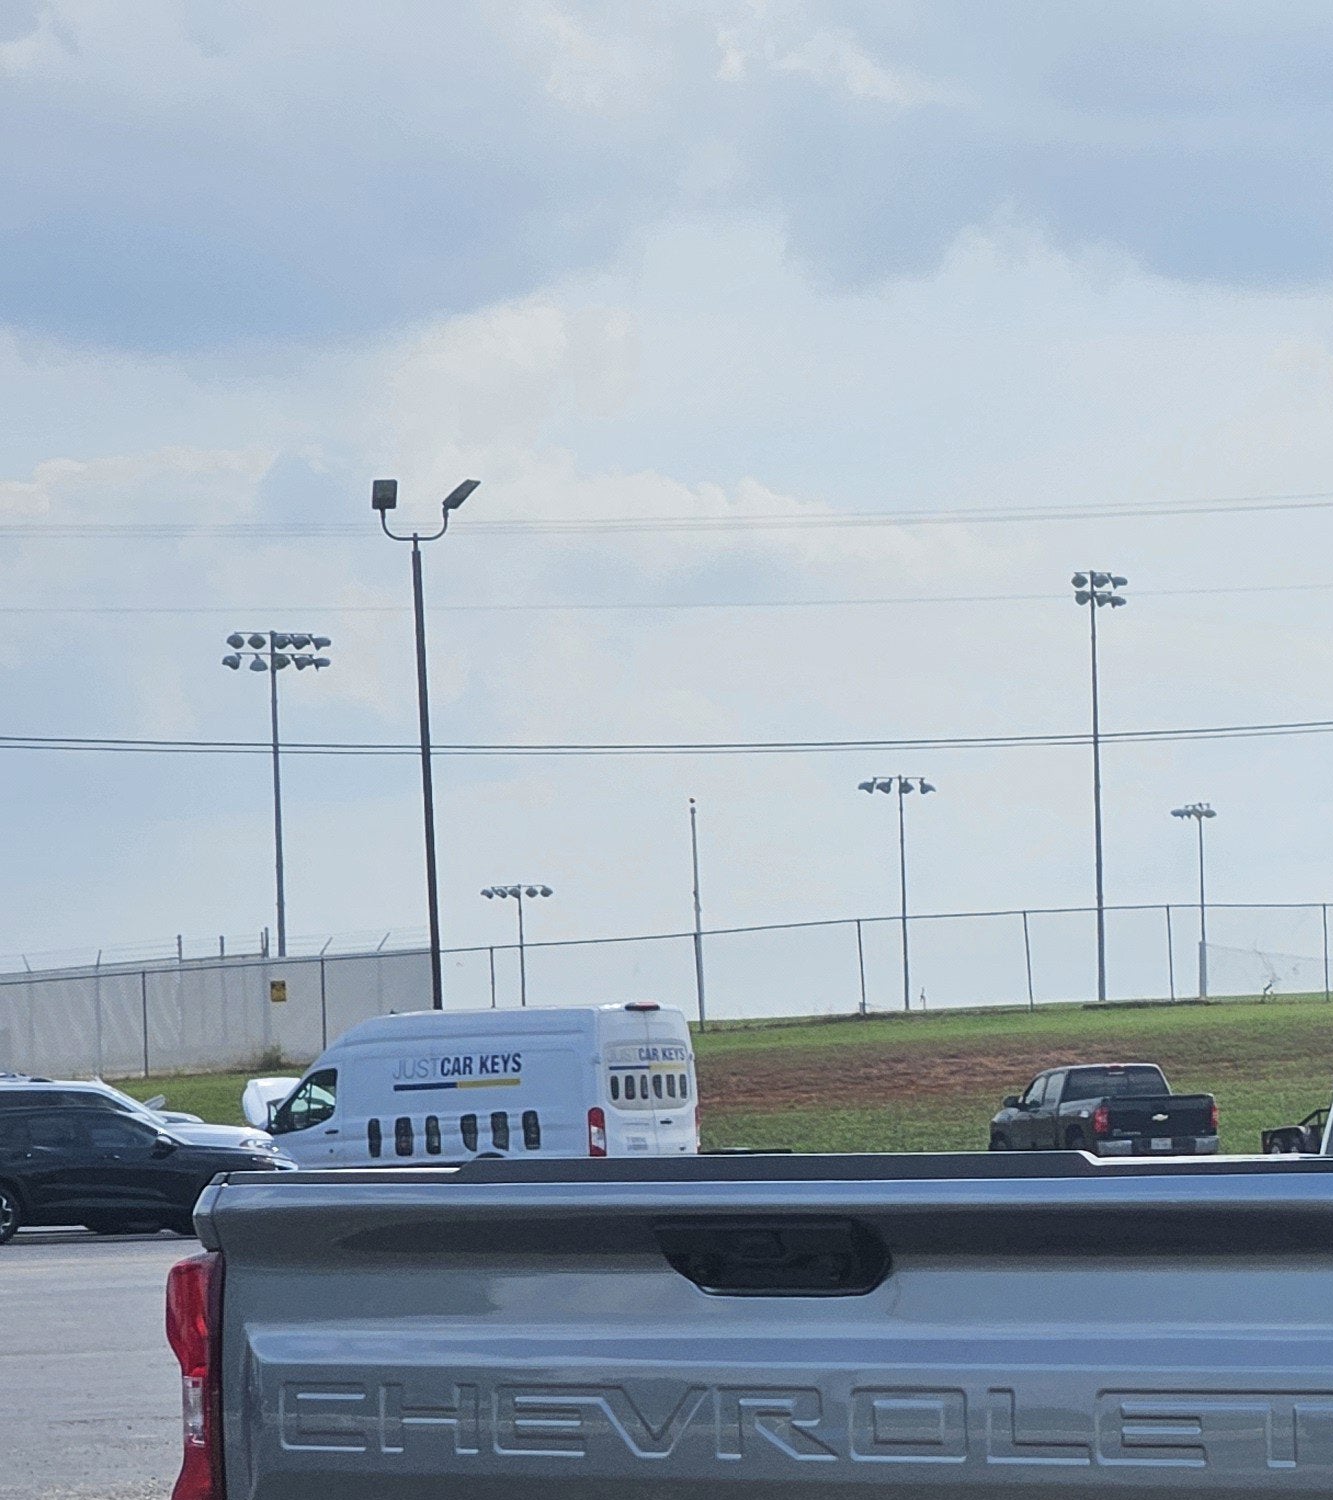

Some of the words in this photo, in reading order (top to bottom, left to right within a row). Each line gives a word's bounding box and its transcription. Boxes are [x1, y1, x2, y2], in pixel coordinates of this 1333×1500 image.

[638, 1046, 660, 1062] CAR
[661, 1046, 686, 1061] KEYS
[440, 1056, 473, 1077] CAR
[479, 1052, 522, 1075] KEYS
